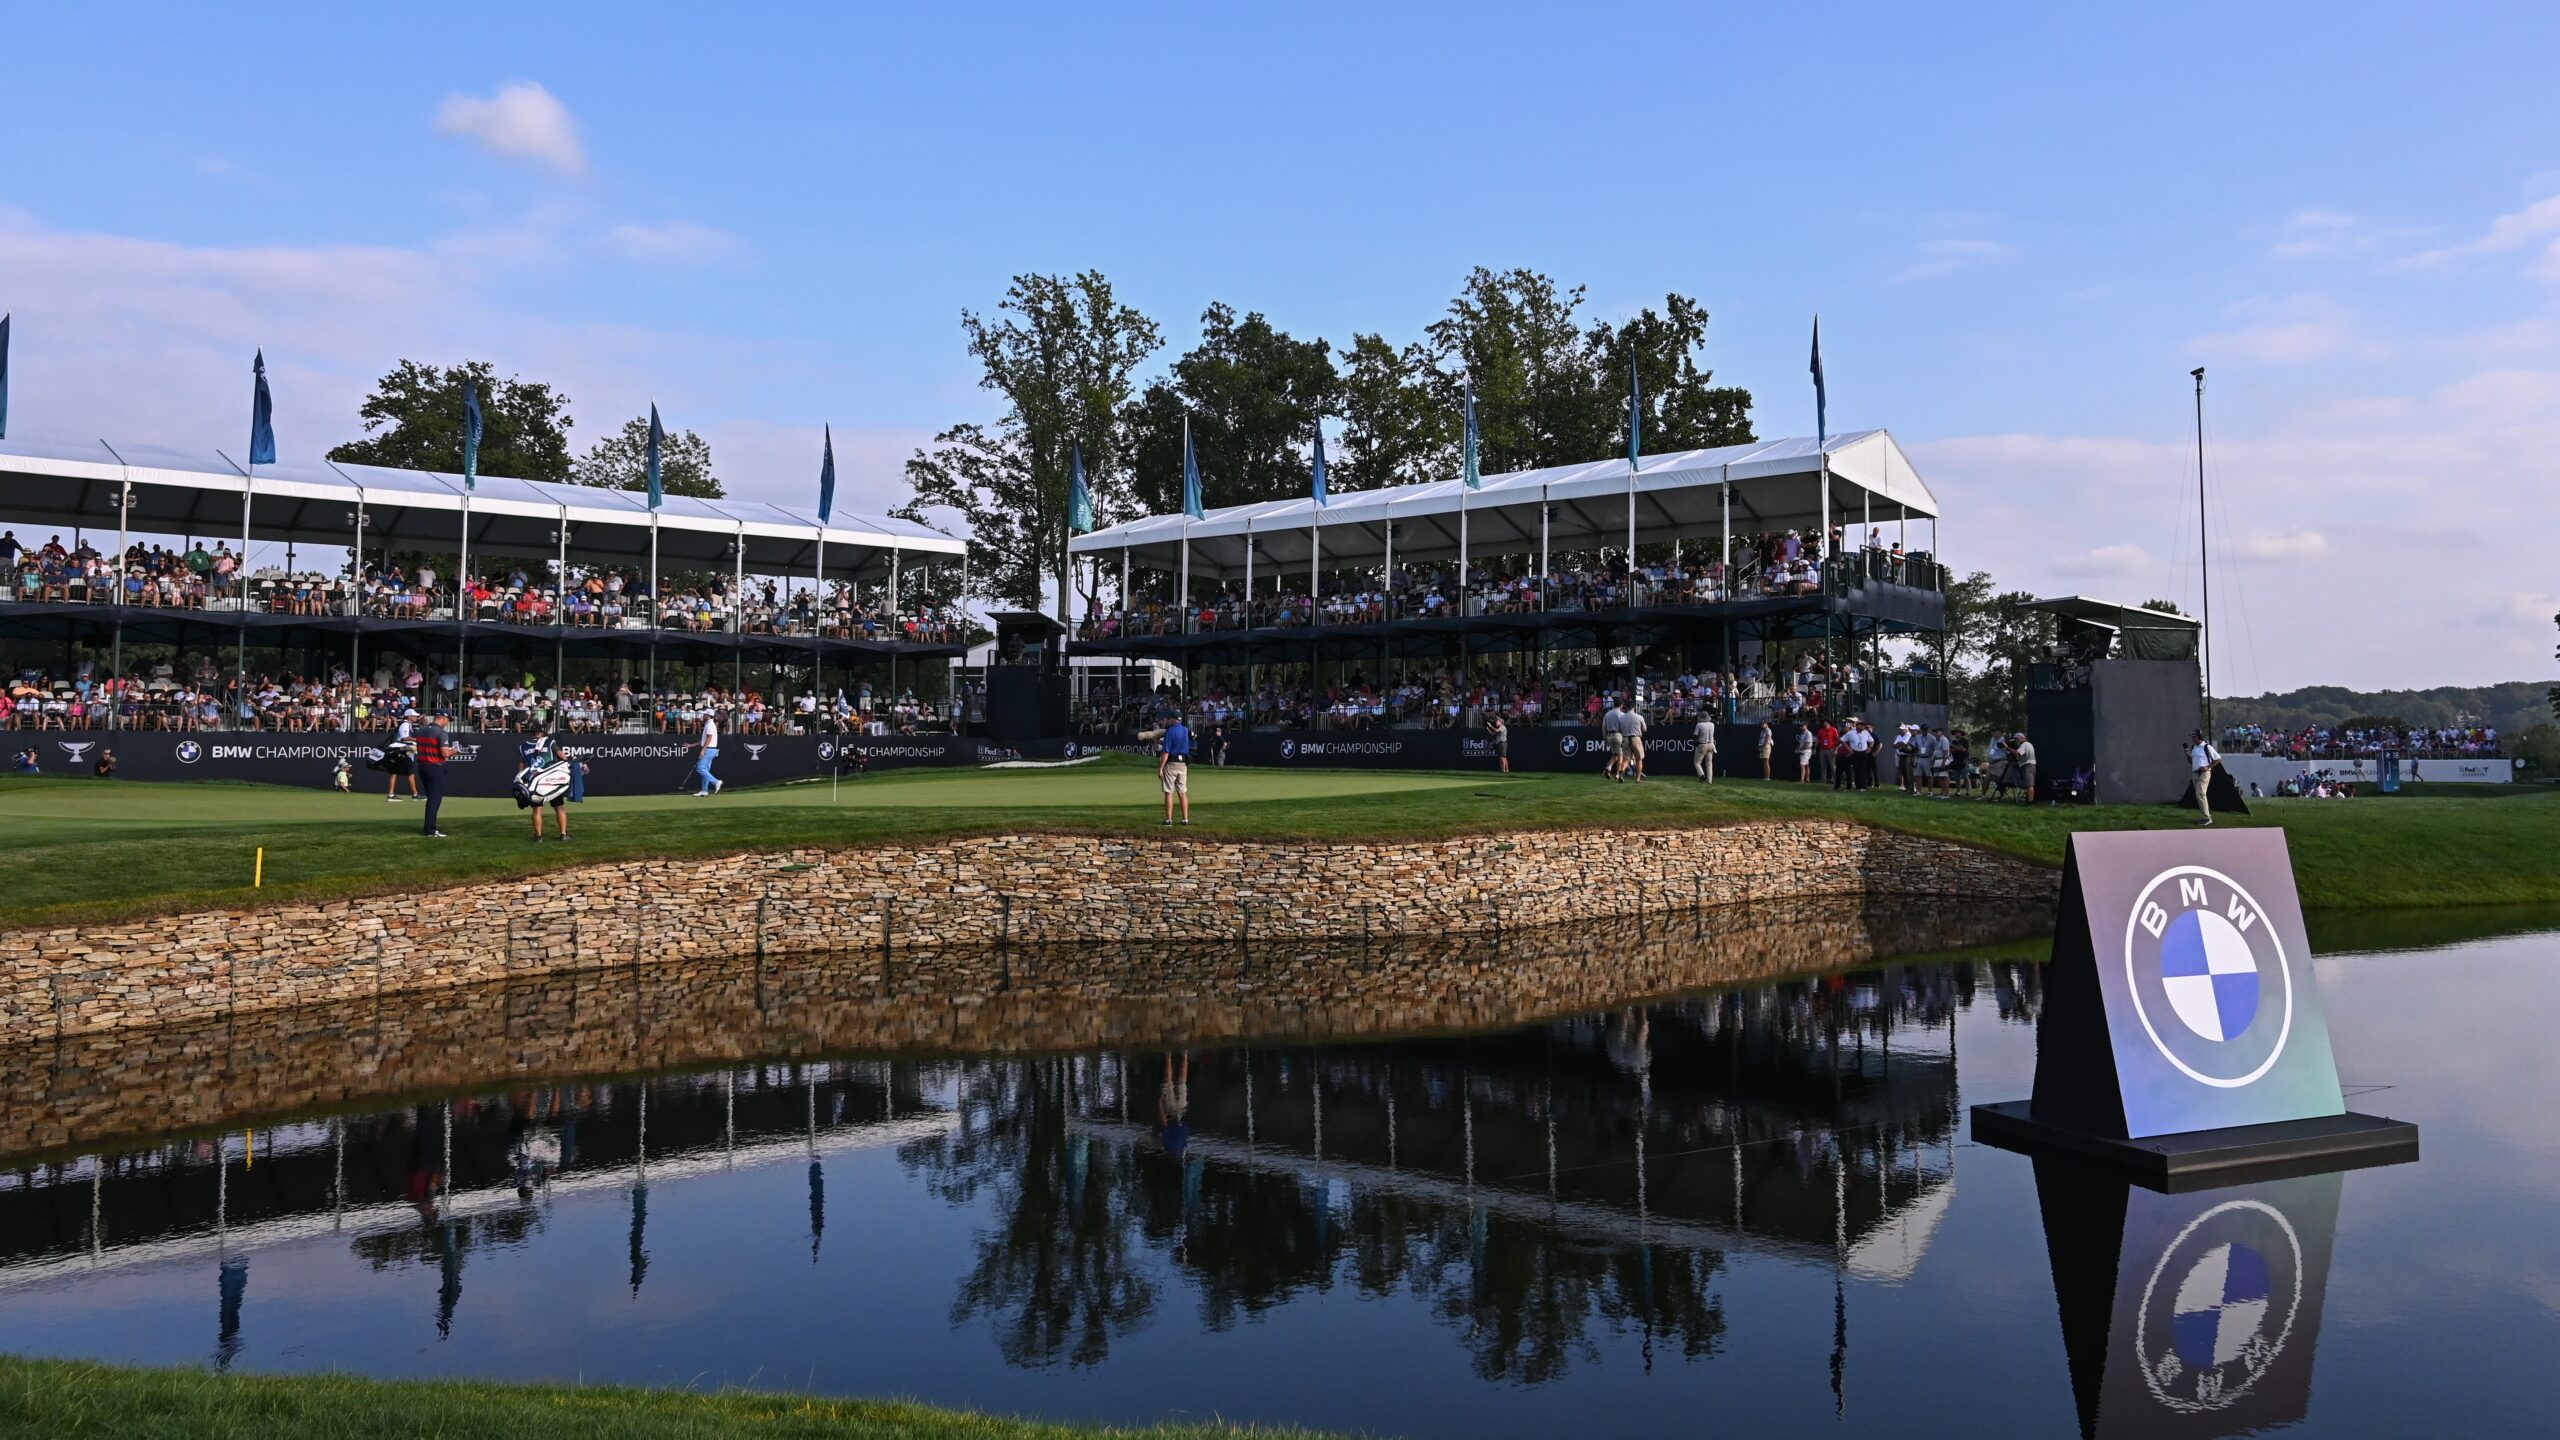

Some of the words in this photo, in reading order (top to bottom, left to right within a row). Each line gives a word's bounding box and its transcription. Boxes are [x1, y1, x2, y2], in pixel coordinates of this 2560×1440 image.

[212, 746, 252, 758] BMW
[256, 746, 371, 758] CHAMPIONSHIP
[562, 747, 594, 757] BMW
[597, 746, 689, 758] CHAMPIONSHIP
[869, 746, 945, 757] CHAMPIONSHIP
[1082, 746, 1102, 755] BMW
[1301, 743, 1325, 754] BMW
[1326, 743, 1402, 754] CHAMPIONSHIP
[2140, 877, 2257, 939] BMW
